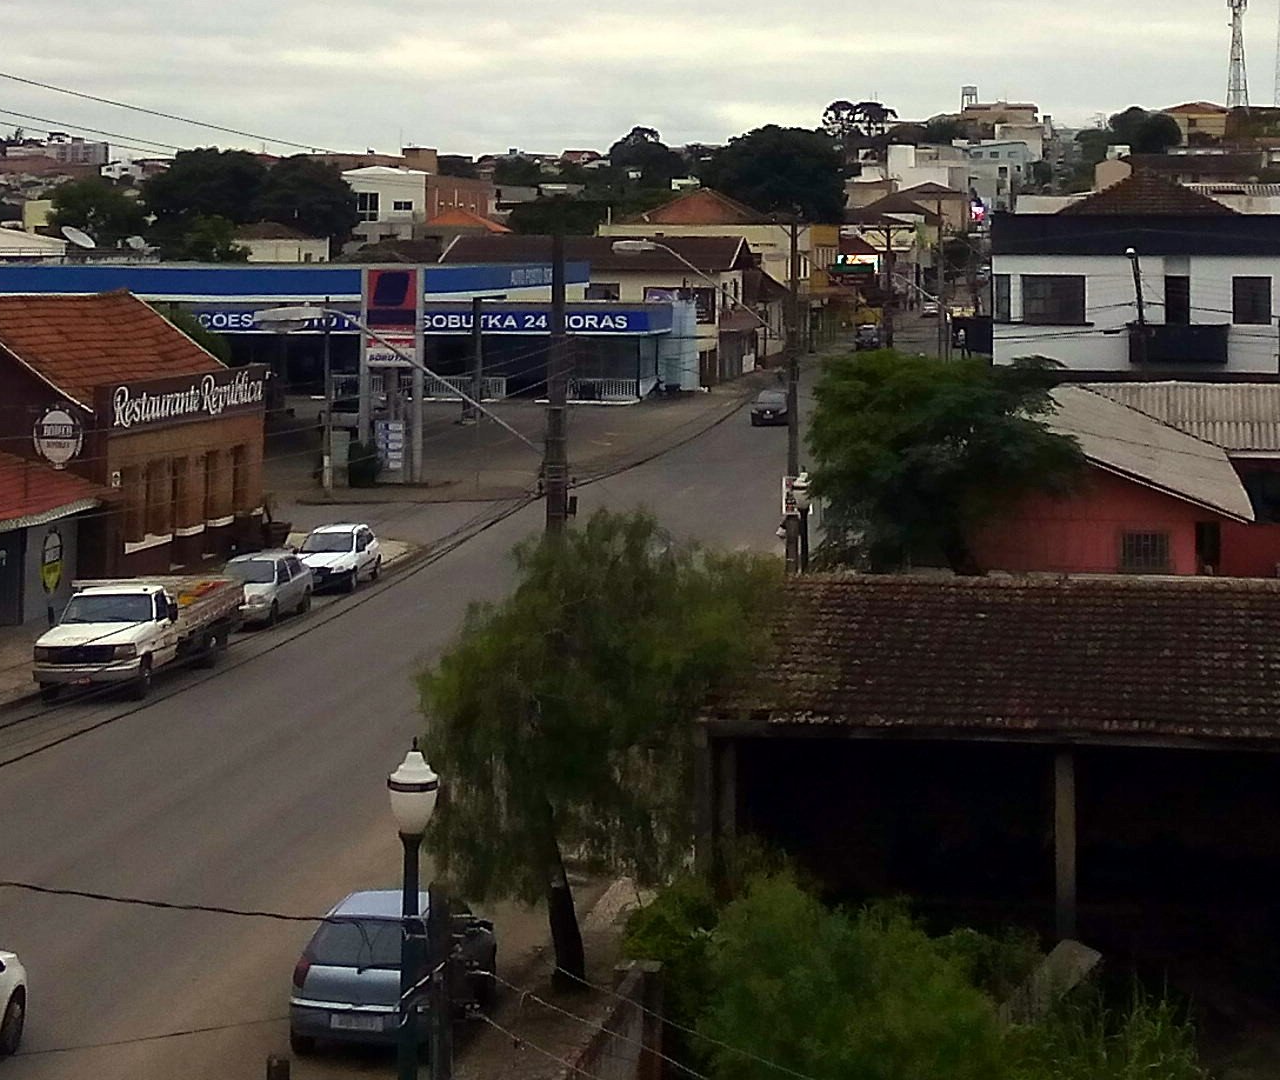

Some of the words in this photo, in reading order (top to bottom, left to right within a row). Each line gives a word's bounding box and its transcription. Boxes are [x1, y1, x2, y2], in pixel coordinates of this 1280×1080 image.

[524, 314, 548, 328] 24
[565, 314, 628, 328] ORAS
[113, 385, 200, 428] Restaurante
